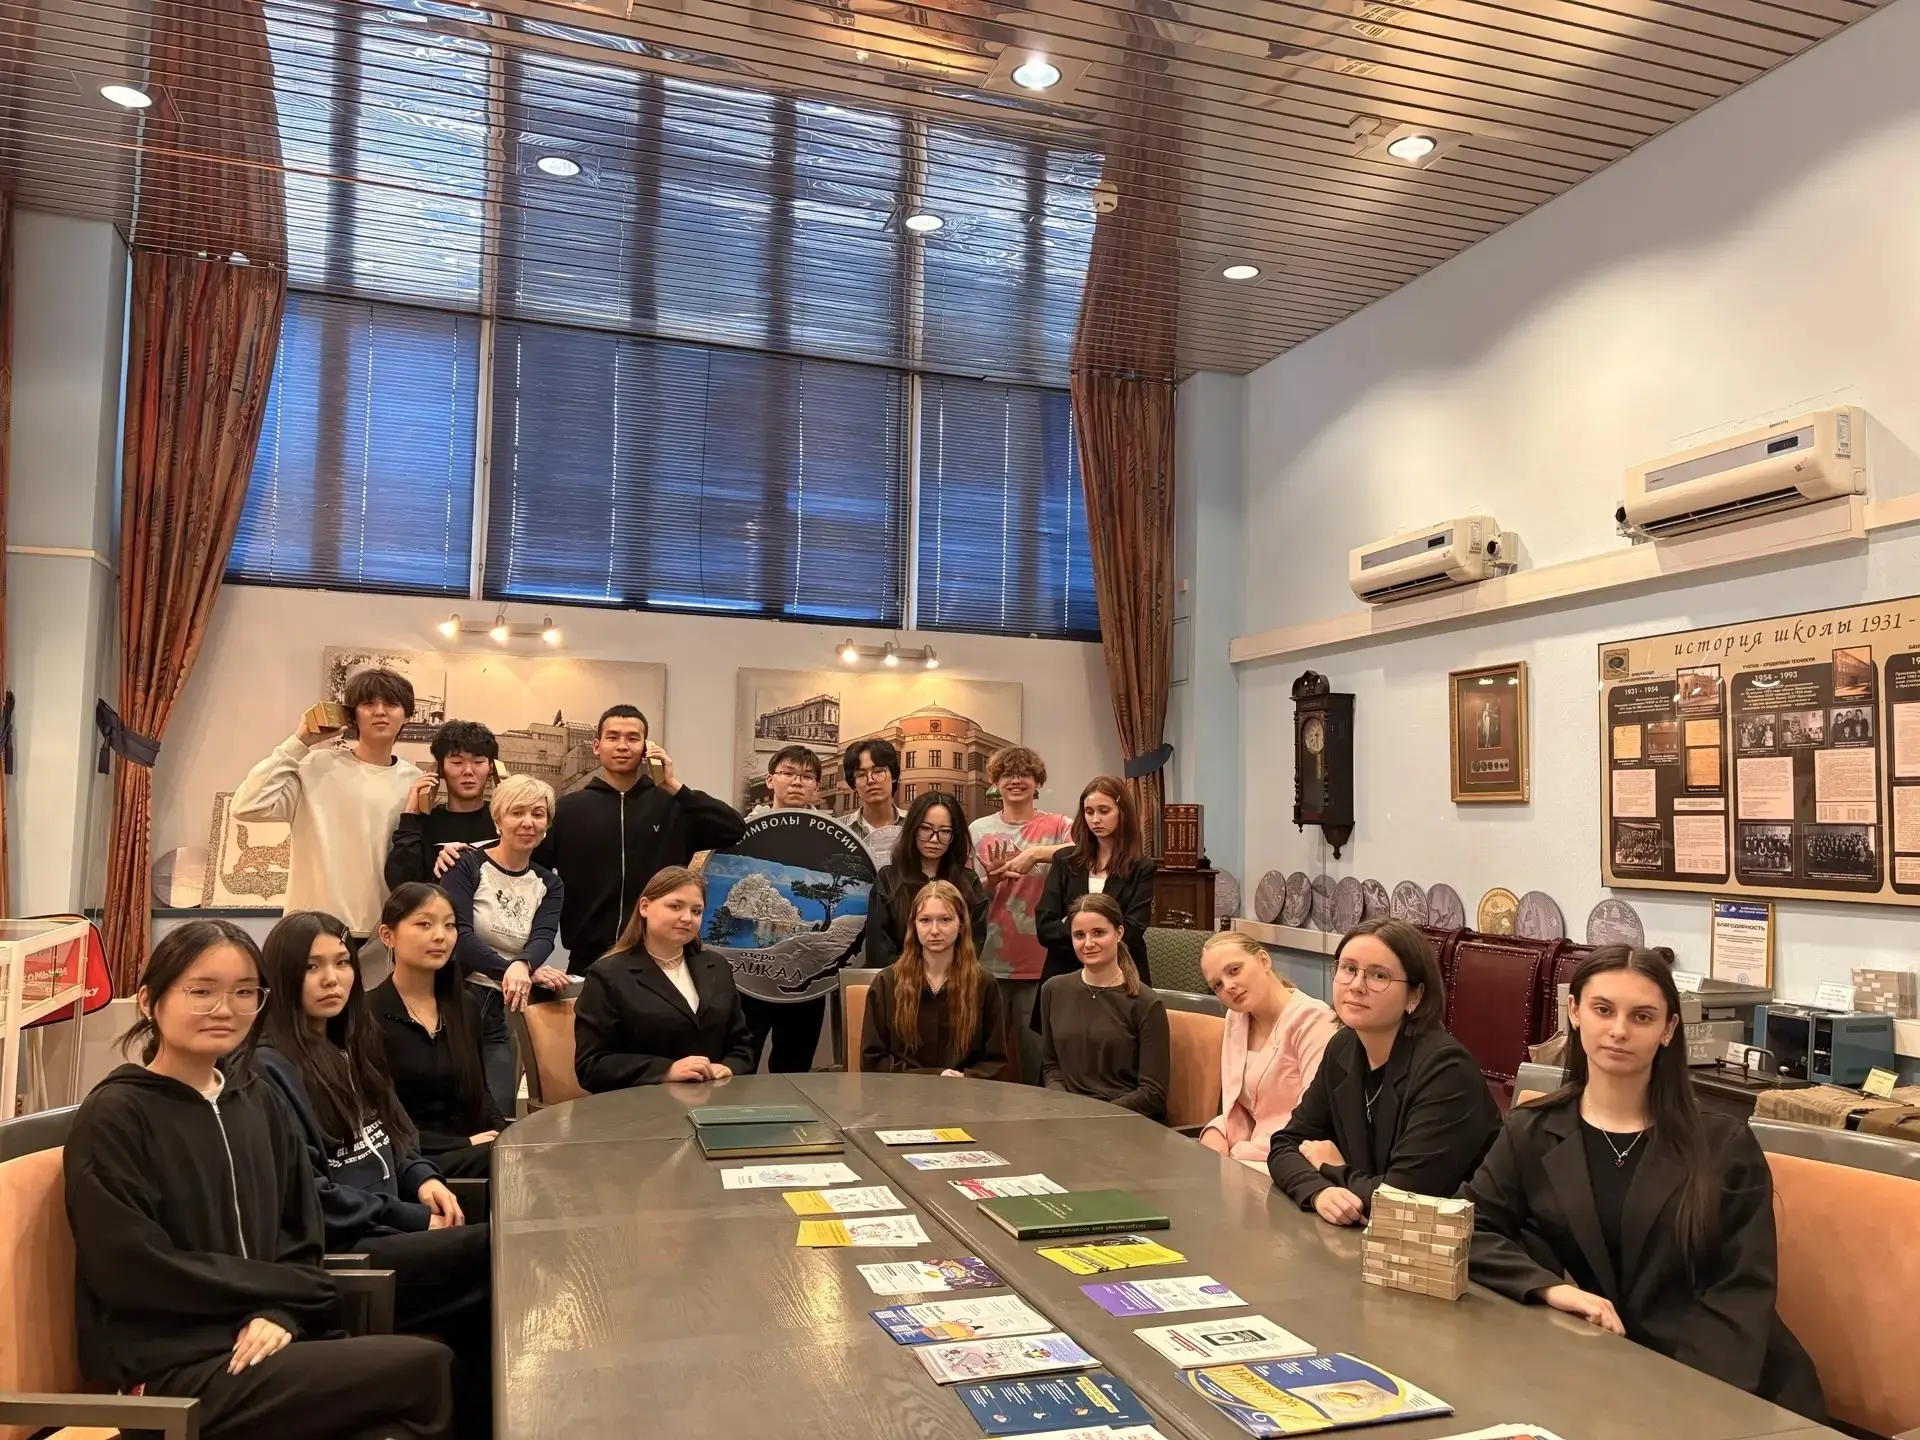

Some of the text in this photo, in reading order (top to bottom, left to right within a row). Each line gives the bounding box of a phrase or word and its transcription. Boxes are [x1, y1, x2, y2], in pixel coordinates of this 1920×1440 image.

[1674, 631, 1762, 657] история
[1774, 619, 1852, 643] школы
[1860, 612, 1901, 633] 1931
[1754, 673, 1772, 682] 1954
[1779, 671, 1798, 679] 1993
[1644, 685, 1659, 693] 1954
[736, 816, 858, 853] ИМВОЛЫ РОССИИ
[1716, 922, 1766, 931] БЛАГОДАРНОСТЬ
[740, 951, 776, 963] озеро
